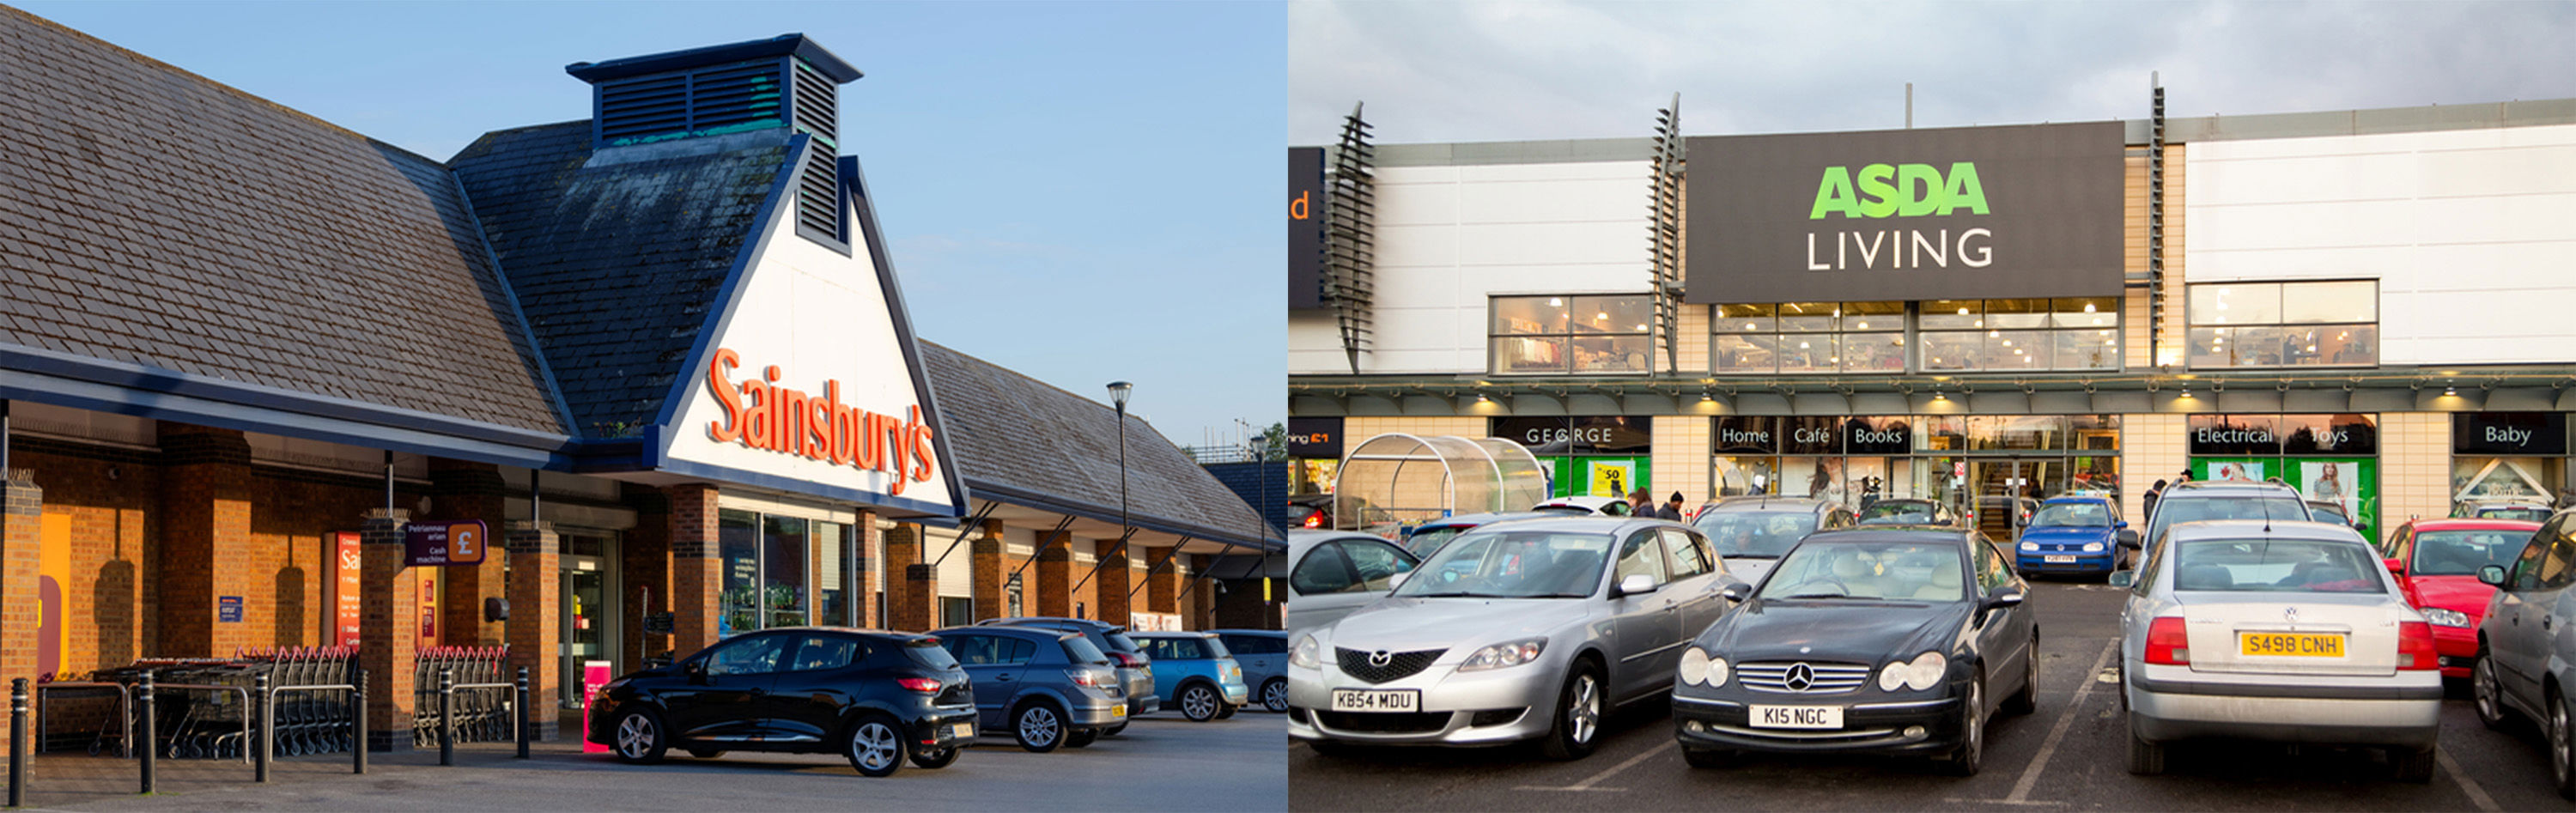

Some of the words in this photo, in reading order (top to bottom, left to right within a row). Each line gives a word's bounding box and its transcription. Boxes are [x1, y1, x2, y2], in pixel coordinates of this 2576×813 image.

[1809, 162, 1990, 220] ASDA
[1808, 228, 1992, 270] LIVING
[708, 348, 934, 495] Sainsbury's
[1527, 428, 1613, 443] GEORGE
[1722, 428, 1769, 443] Home
[1794, 427, 1830, 443] Café
[1855, 428, 1903, 444] Books
[2197, 428, 2273, 443] Electrical
[2311, 427, 2349, 446] Toys
[2485, 426, 2532, 446] Baby
[429, 546, 447, 555] Cash
[2249, 635, 2297, 653] S498
[2300, 636, 2337, 654] CNH
[1337, 692, 1375, 708] KB54
[1378, 693, 1411, 709] MDU
[1794, 708, 1827, 725] NGC
